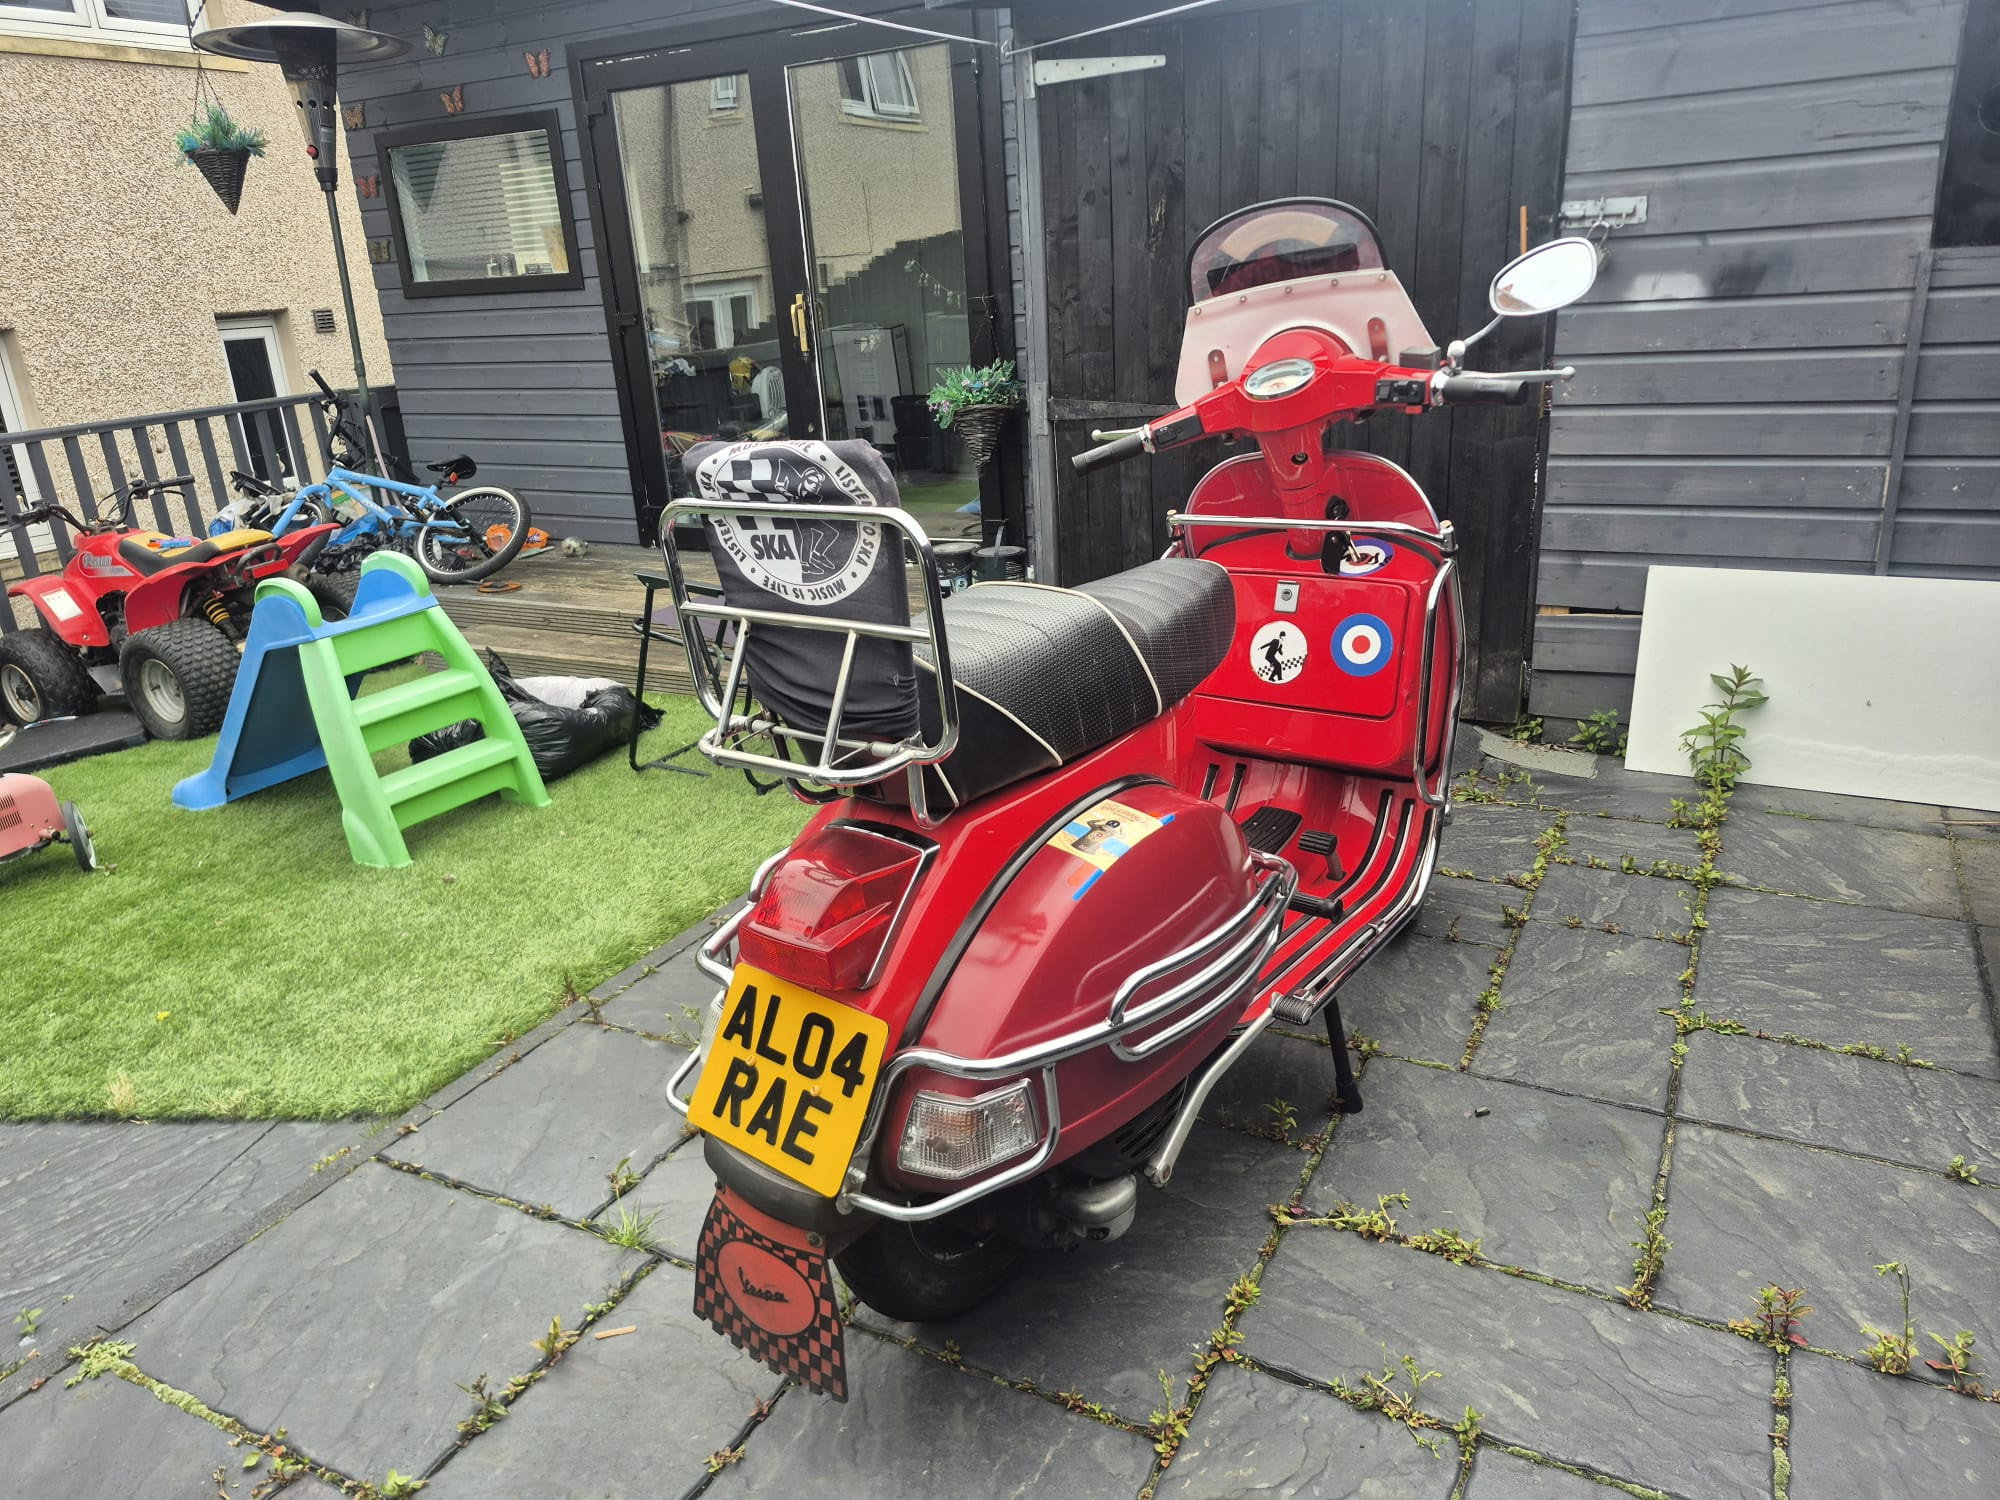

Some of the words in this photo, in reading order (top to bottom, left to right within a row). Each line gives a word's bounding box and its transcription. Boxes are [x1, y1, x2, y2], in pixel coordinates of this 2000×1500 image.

[701, 471, 716, 492] SKA
[714, 518, 747, 562] LISTEN
[750, 534, 797, 560] SKA
[856, 539, 875, 567] SKA
[763, 575, 789, 595] LIFE
[792, 590, 804, 600] IS
[807, 578, 847, 600] MUSIC
[722, 984, 869, 1098] AL04
[713, 1057, 833, 1166] RAE
